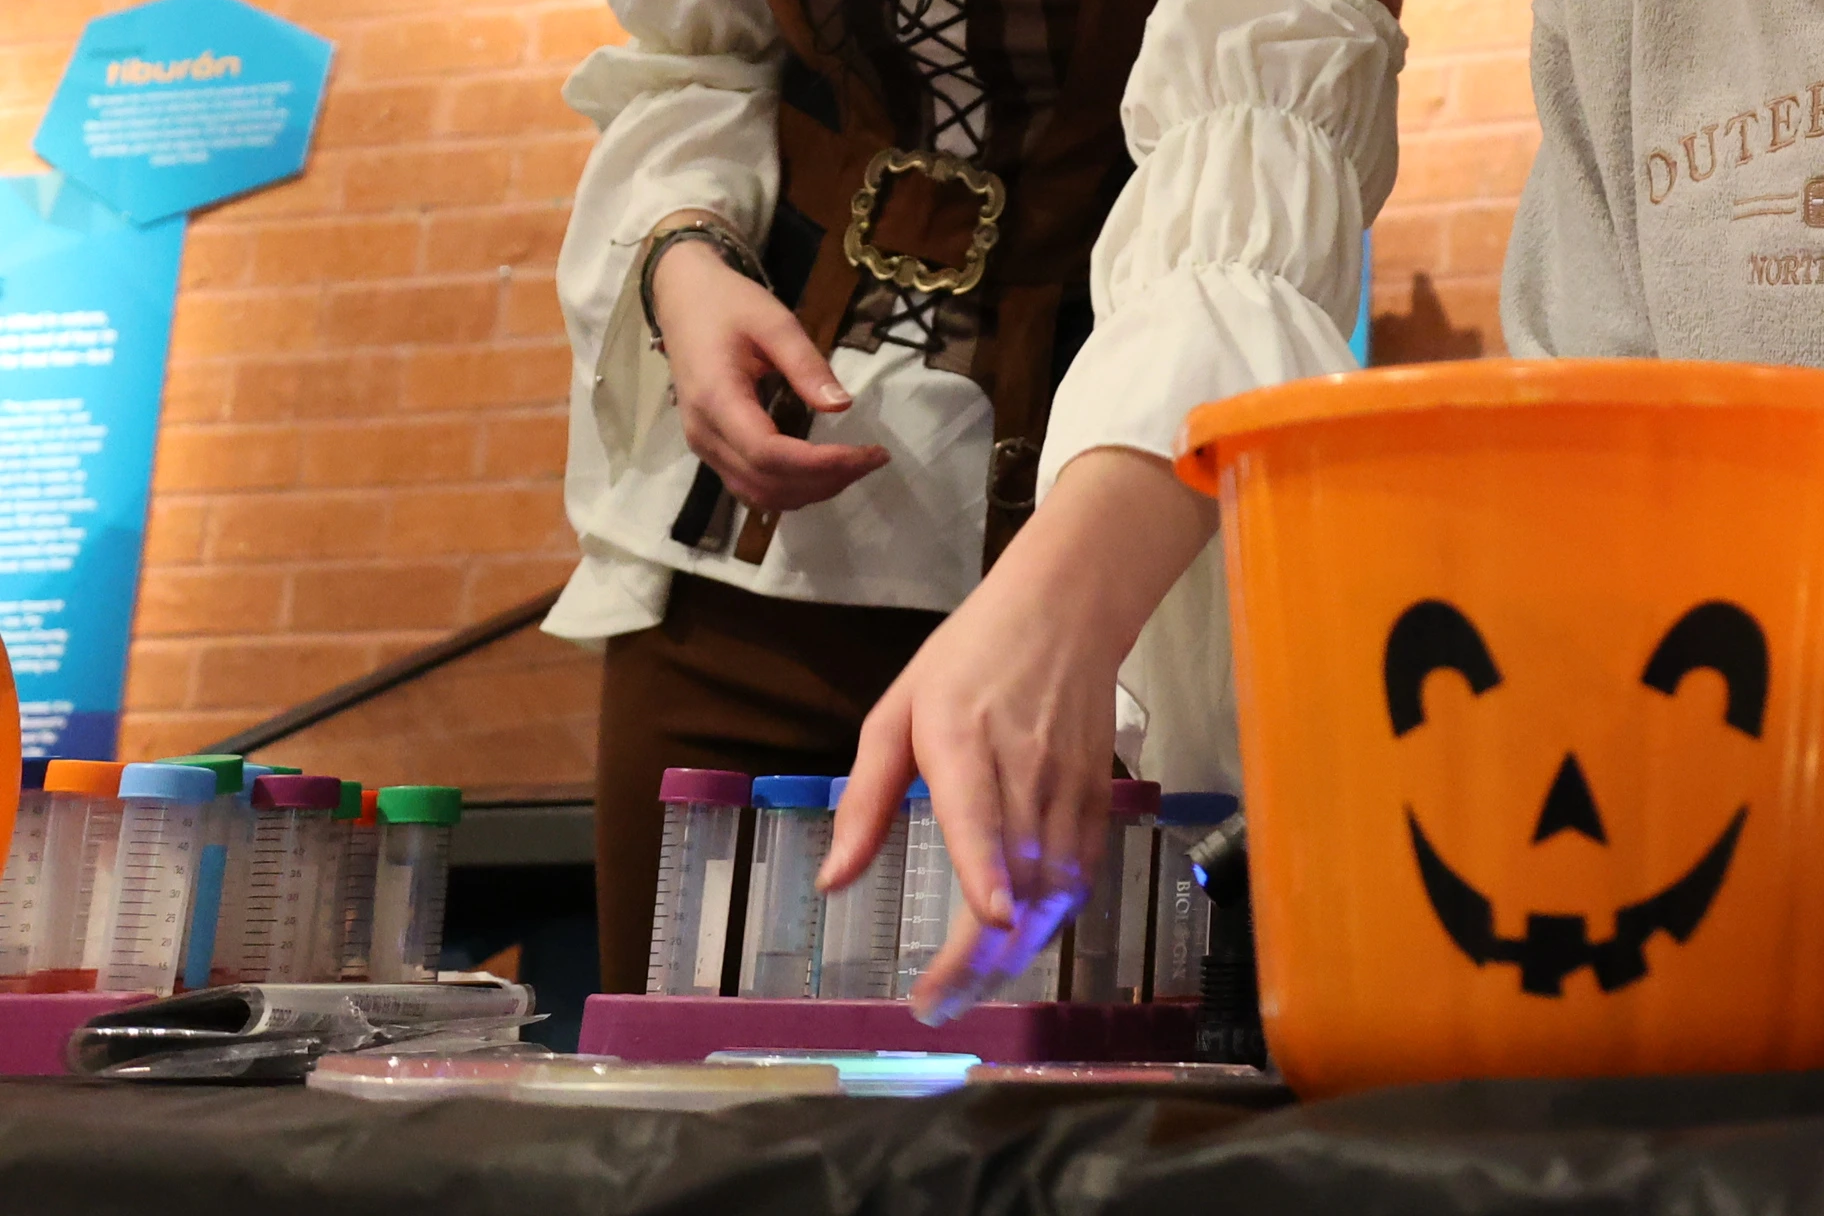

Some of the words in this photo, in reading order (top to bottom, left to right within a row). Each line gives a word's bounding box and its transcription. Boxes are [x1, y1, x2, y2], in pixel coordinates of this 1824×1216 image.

[920, 818, 930, 826] 45
[919, 842, 929, 850] 40
[169, 889, 181, 899] 30
[22, 900, 33, 909] 25
[165, 913, 176, 923] 25
[912, 916, 922, 924] 25
[20, 924, 31, 932] 20
[161, 938, 172, 947] 20
[281, 940, 293, 949] 20
[670, 937, 682, 946] 20
[910, 941, 920, 949] 20
[908, 967, 917, 976] 15
